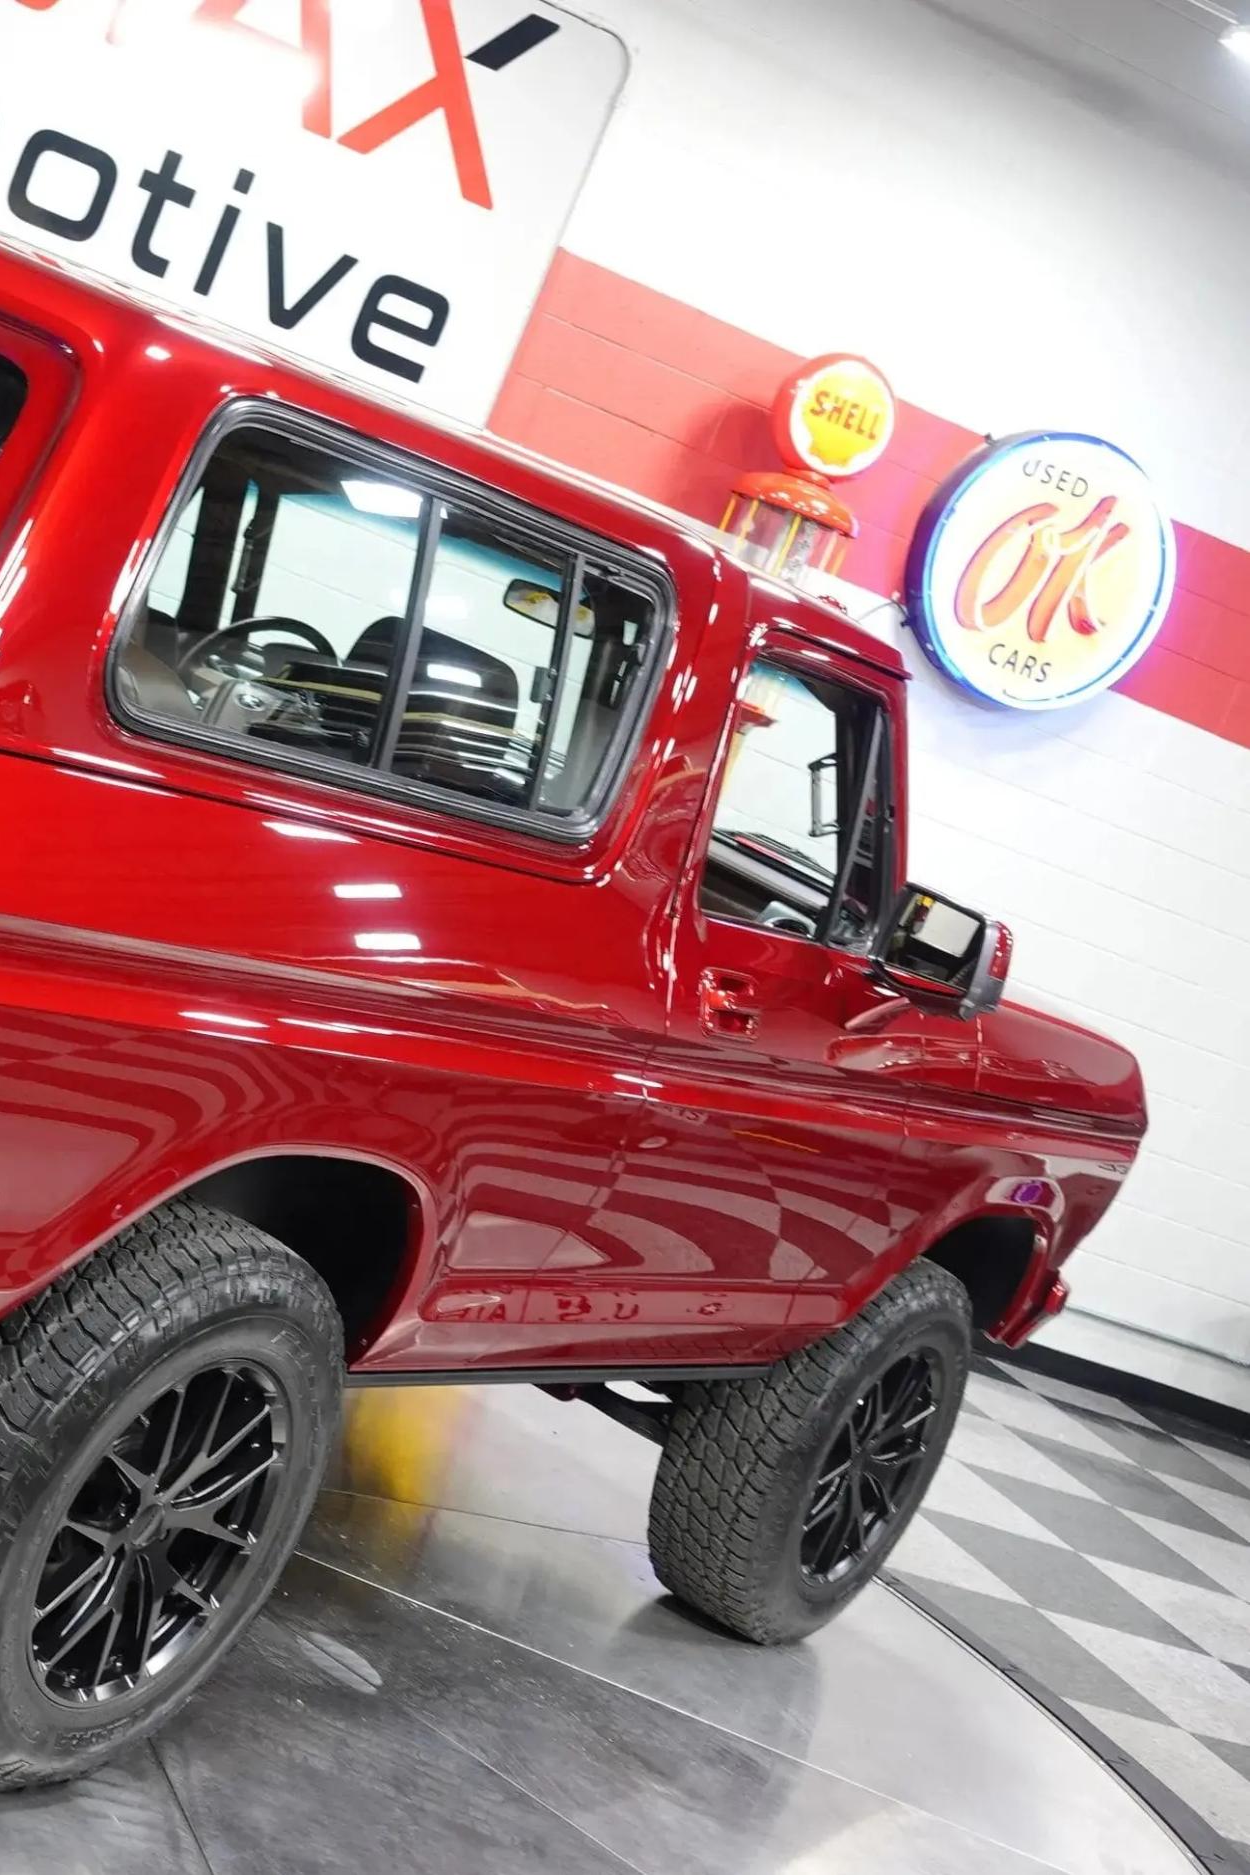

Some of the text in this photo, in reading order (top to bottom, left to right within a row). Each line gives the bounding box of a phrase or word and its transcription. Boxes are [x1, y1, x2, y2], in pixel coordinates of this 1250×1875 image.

[809, 390, 880, 441] SHELL
[1021, 459, 1089, 498] USED
[953, 494, 1131, 644] OK
[988, 643, 1052, 684] CARS
